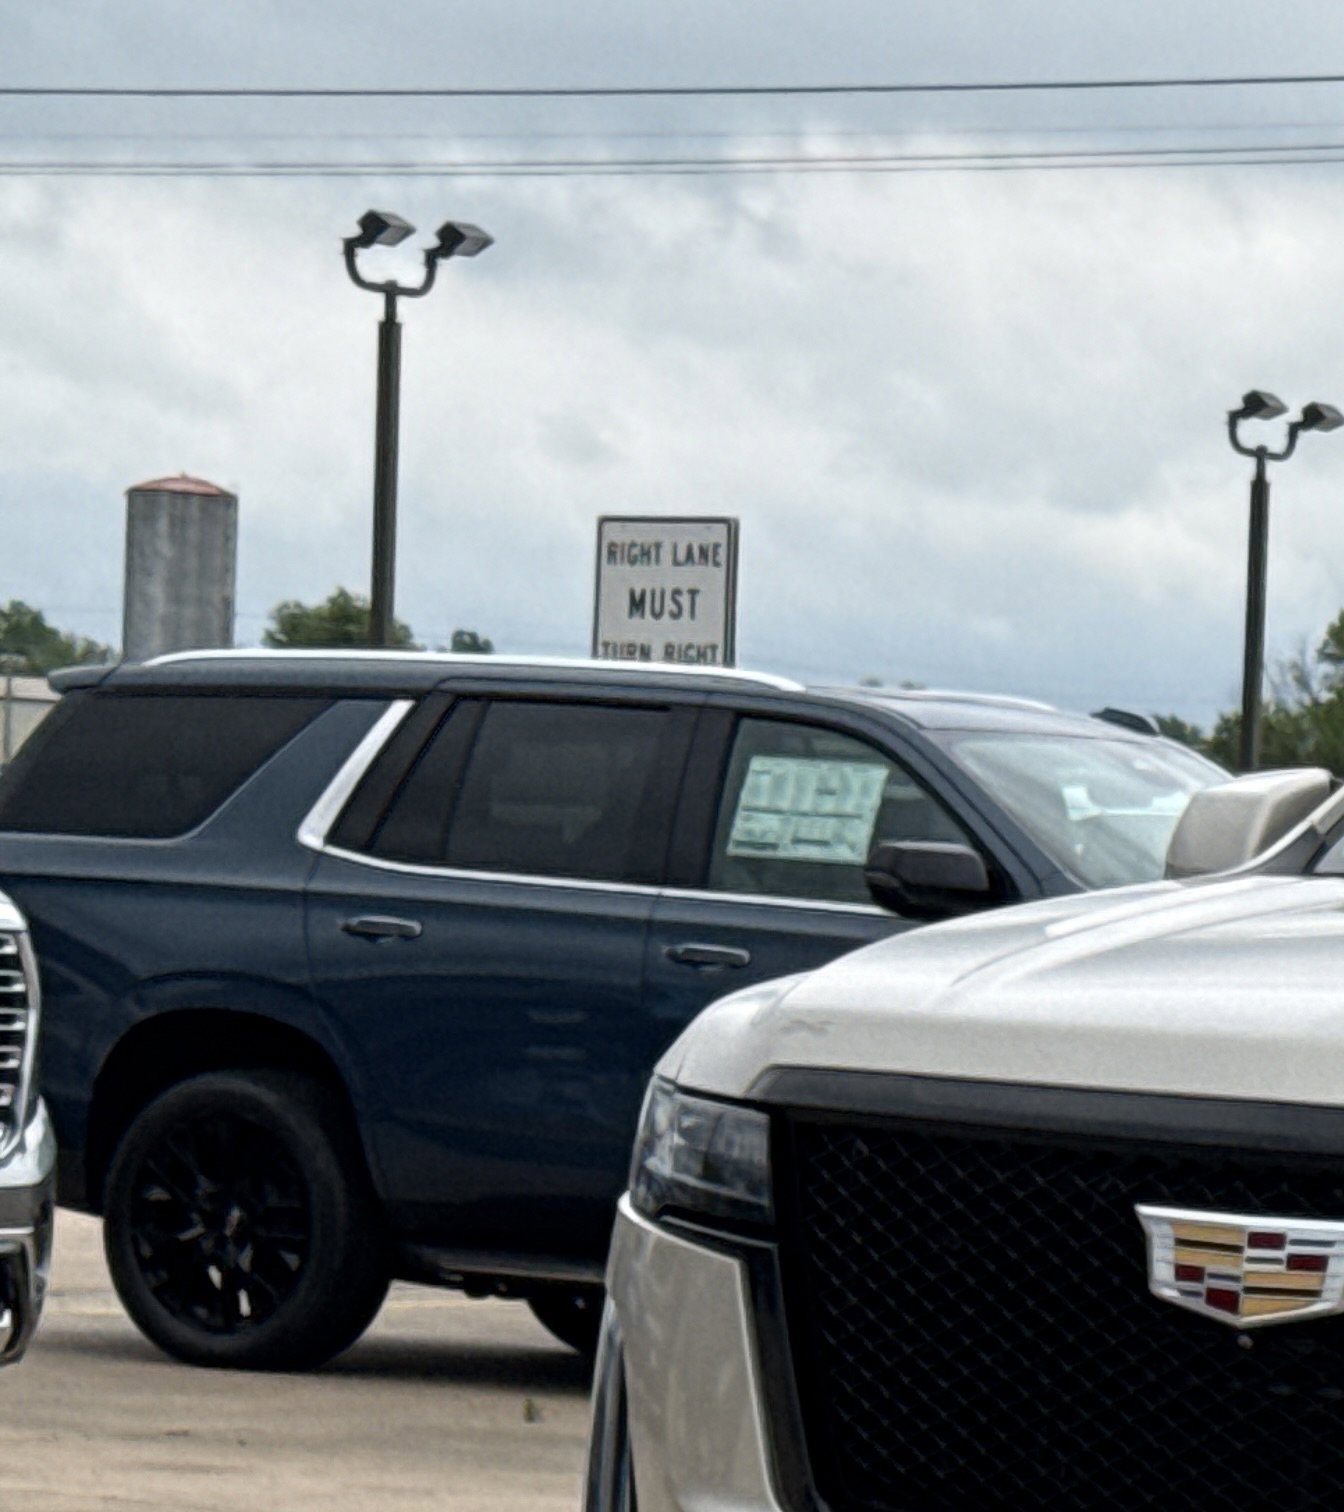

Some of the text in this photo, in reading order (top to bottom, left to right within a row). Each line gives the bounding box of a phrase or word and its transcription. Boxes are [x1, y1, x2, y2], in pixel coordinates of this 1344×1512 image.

[606, 540, 723, 568] RIGHT LANE
[627, 587, 701, 621] MUST
[663, 642, 719, 664] RIGHT
